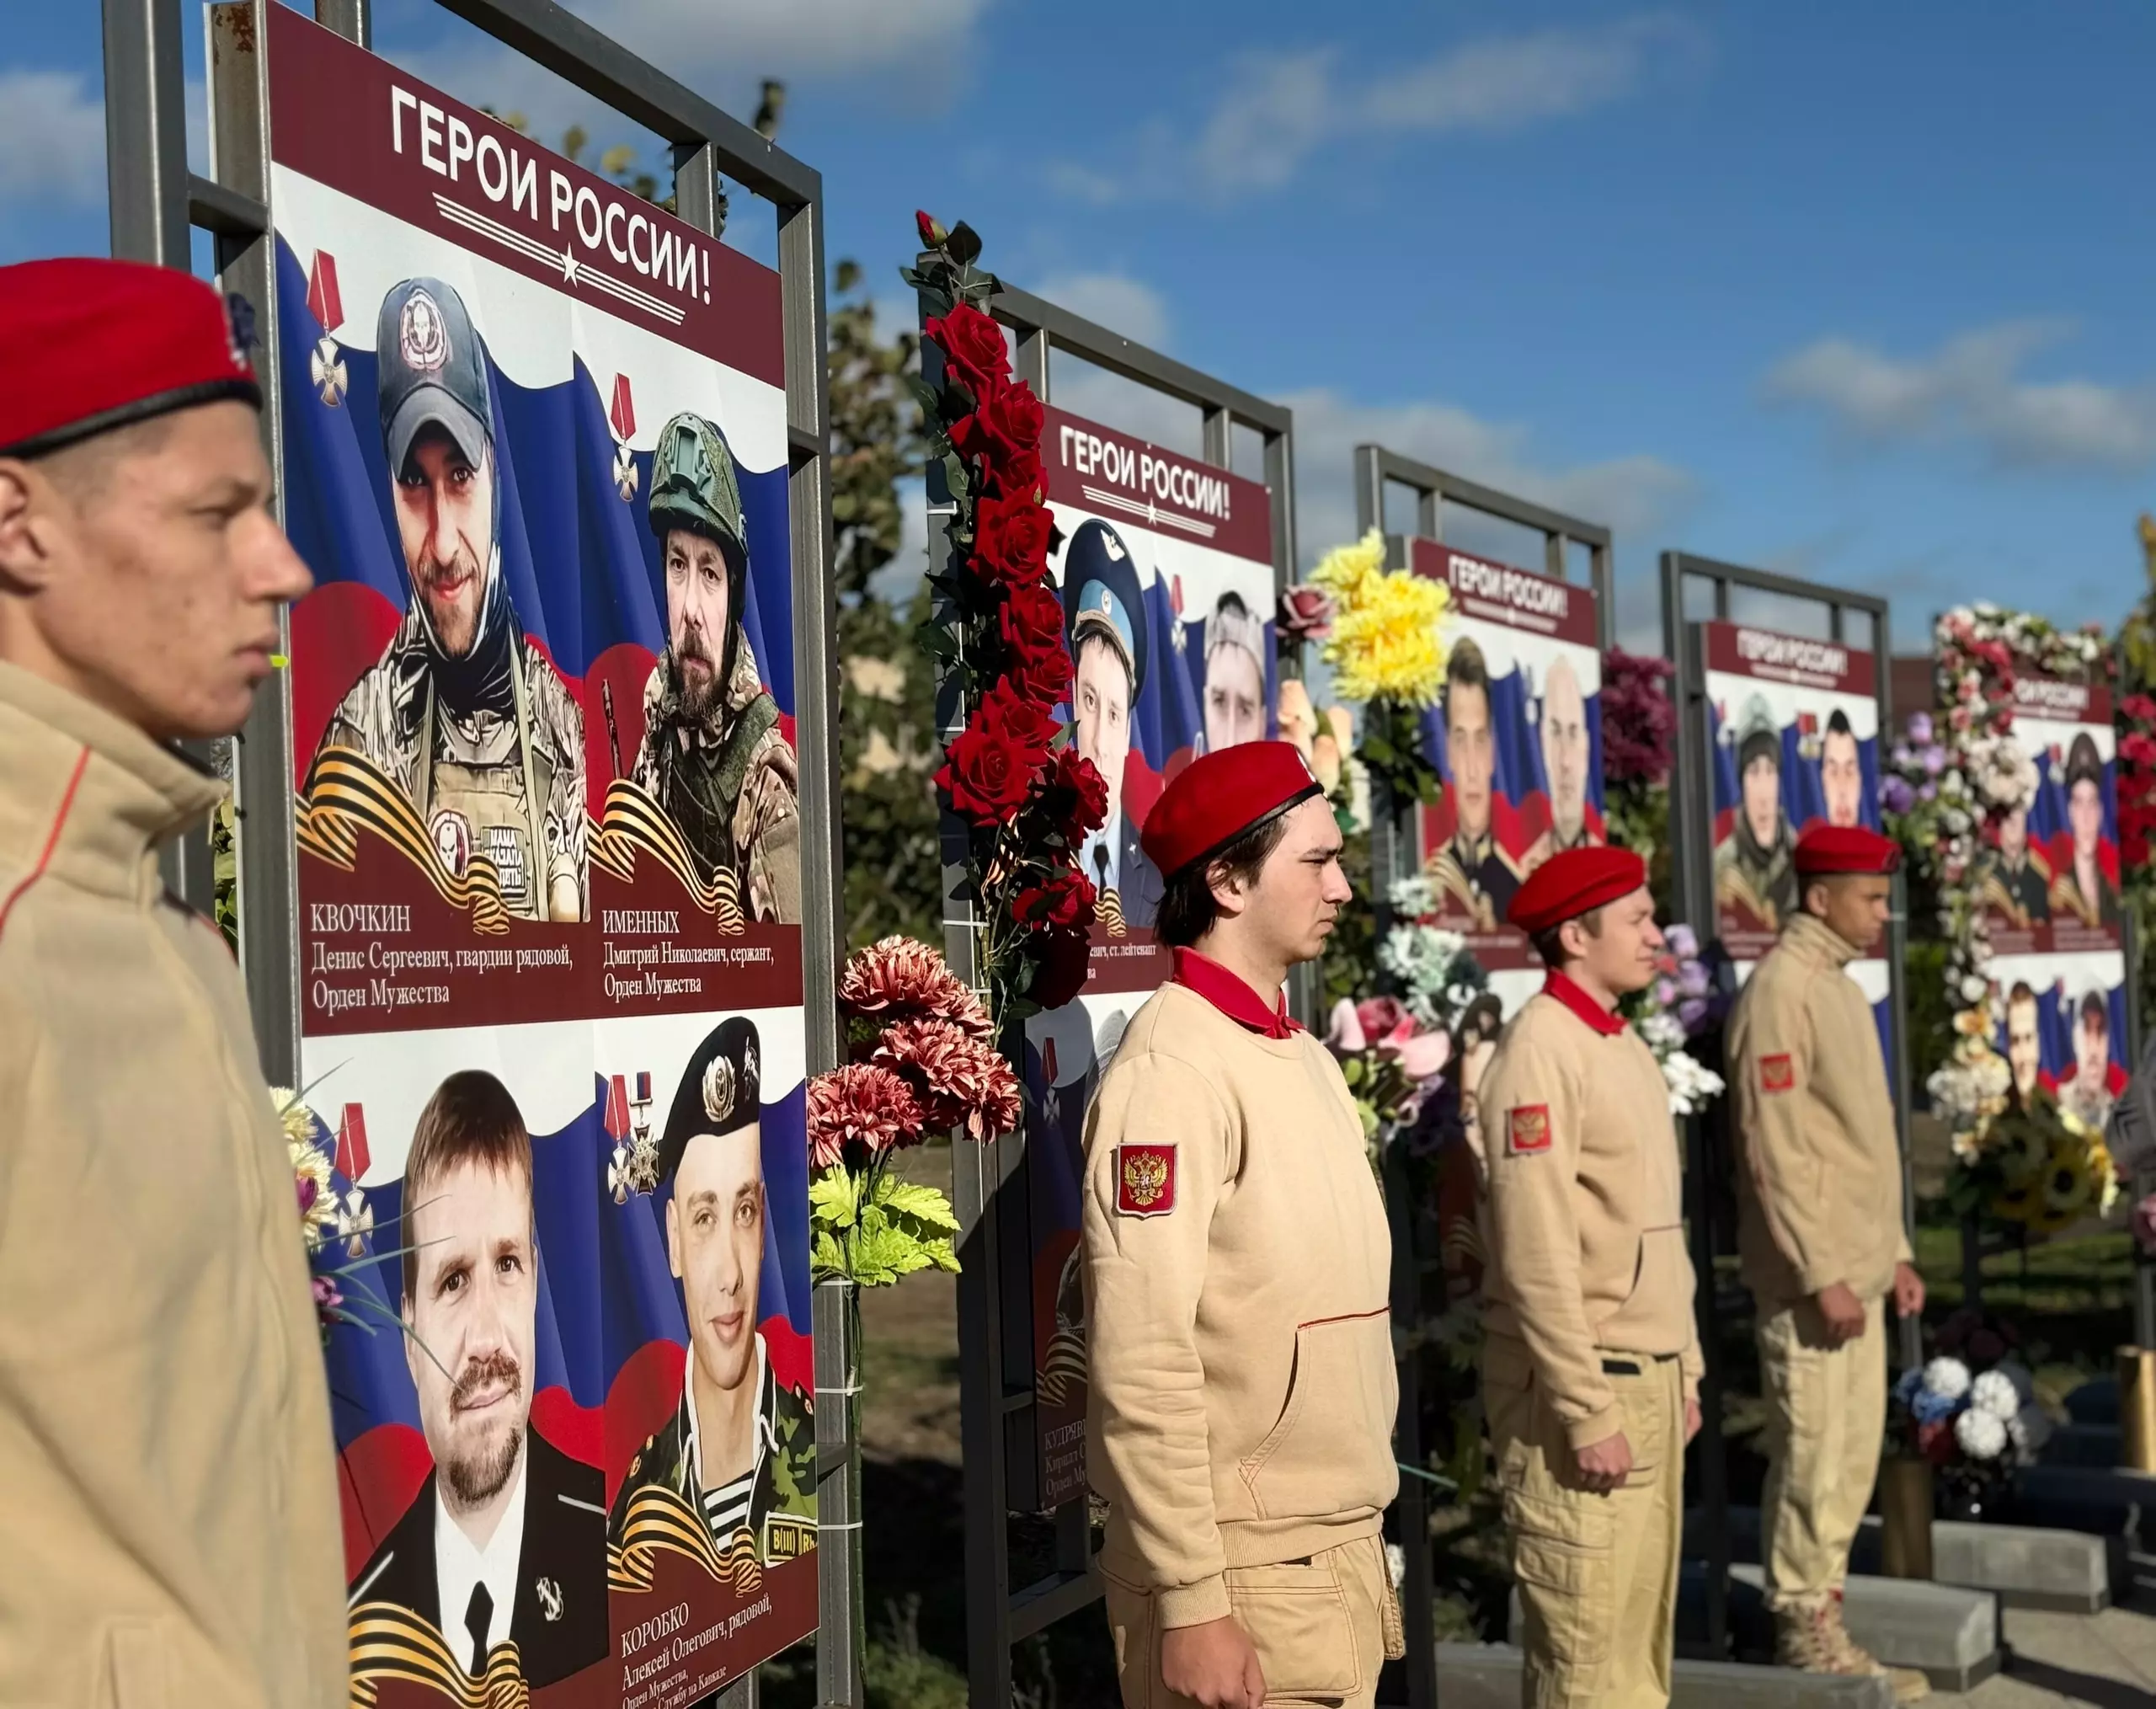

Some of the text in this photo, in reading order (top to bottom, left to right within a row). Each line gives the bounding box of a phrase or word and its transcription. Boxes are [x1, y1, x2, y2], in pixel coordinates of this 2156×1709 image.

[392, 85, 712, 305] ГЕРОИ РОССИИ!
[1060, 425, 1230, 521] ГЕРОИ РОССИИ!
[1449, 554, 1502, 601] ГЕРОИ
[310, 904, 411, 932] КВОЧКИН
[602, 911, 680, 933] ИМЕННЫХ
[312, 942, 573, 976] Денис Сергеевич, гвардии рядовой,
[604, 941, 774, 970] Дмитрий Николаевич, сержант,
[1120, 943, 1156, 956] лейтенант
[313, 979, 449, 1017] Орден Мужества
[605, 972, 702, 1003] Орден Мужества
[1044, 1418, 1086, 1450] КУДРЯВ
[621, 1602, 690, 1658] КОРОБКО
[622, 1592, 772, 1691] Алексей Олегович, рядовой,
[648, 1669, 689, 1700] Мужества,
[688, 1683, 697, 1696] на
